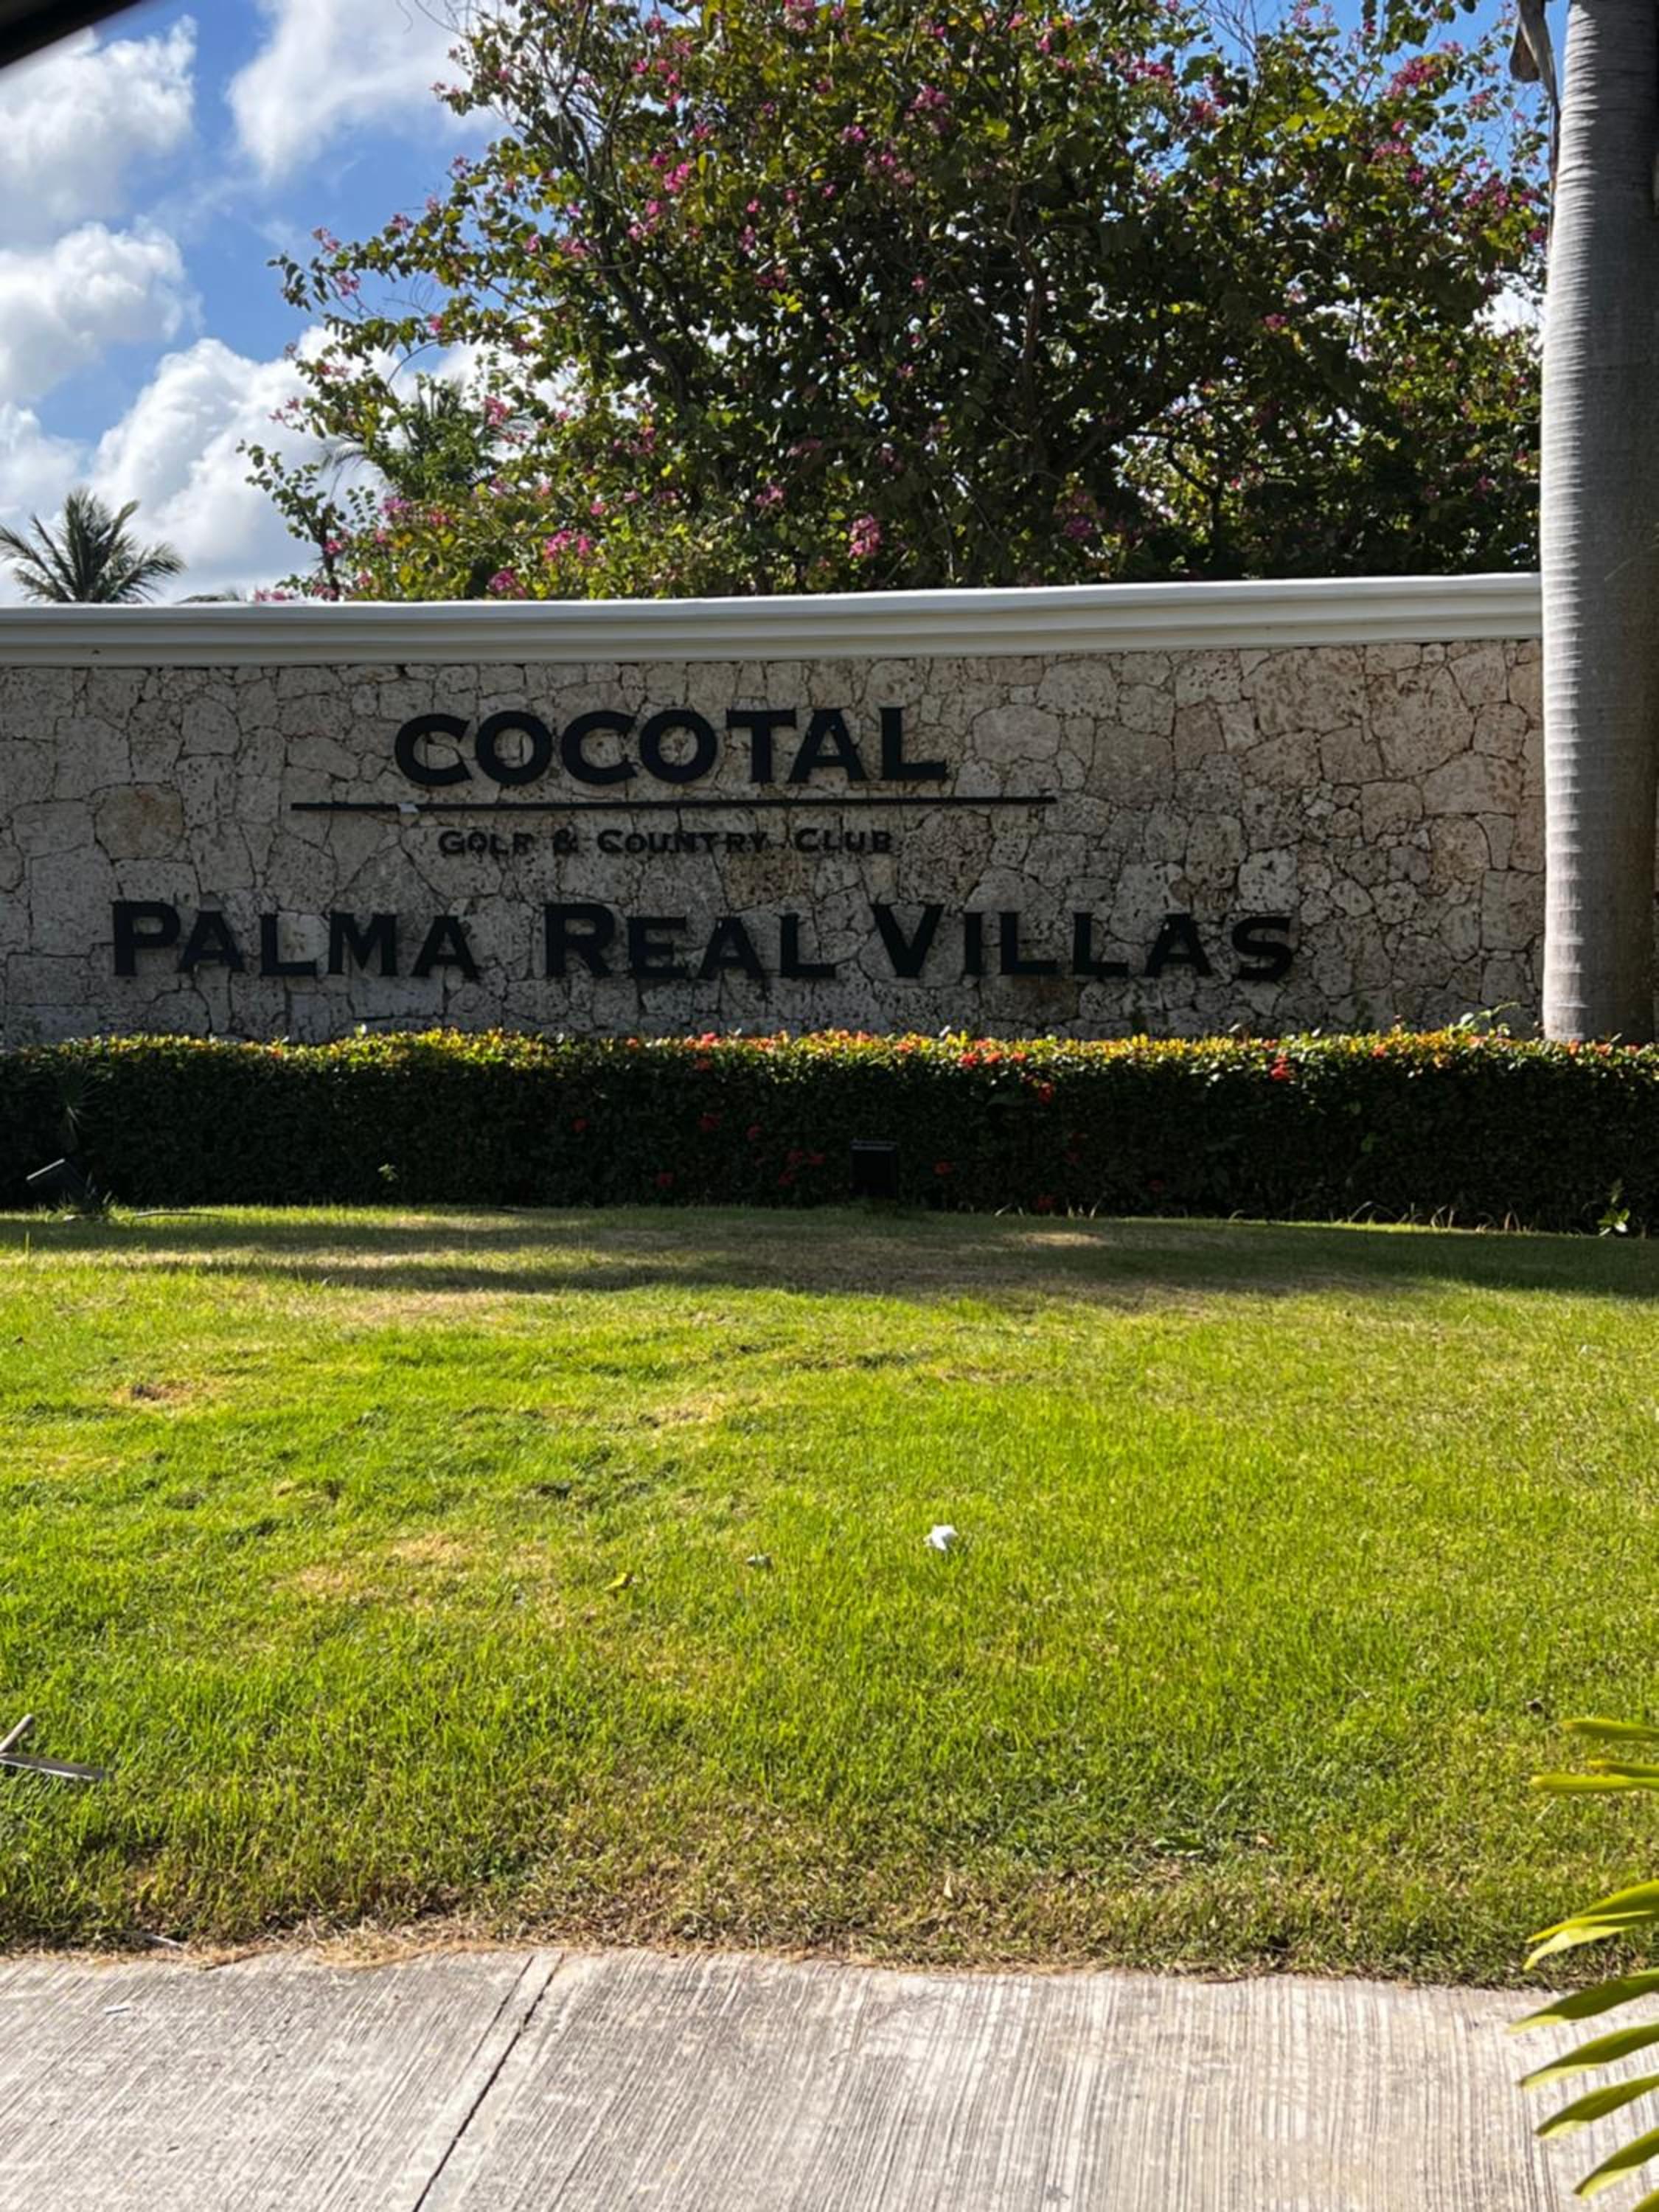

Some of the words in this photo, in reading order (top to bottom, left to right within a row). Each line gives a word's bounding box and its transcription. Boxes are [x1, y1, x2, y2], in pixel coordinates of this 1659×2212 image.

[394, 706, 947, 787] COCOTAL
[438, 830, 534, 856] GOLF
[552, 828, 579, 856] &
[597, 829, 769, 855] COUNTRY
[794, 827, 894, 855] CLUB
[111, 900, 480, 978] PALMA
[543, 902, 836, 979] REAL
[870, 903, 1295, 981] VILLAS
